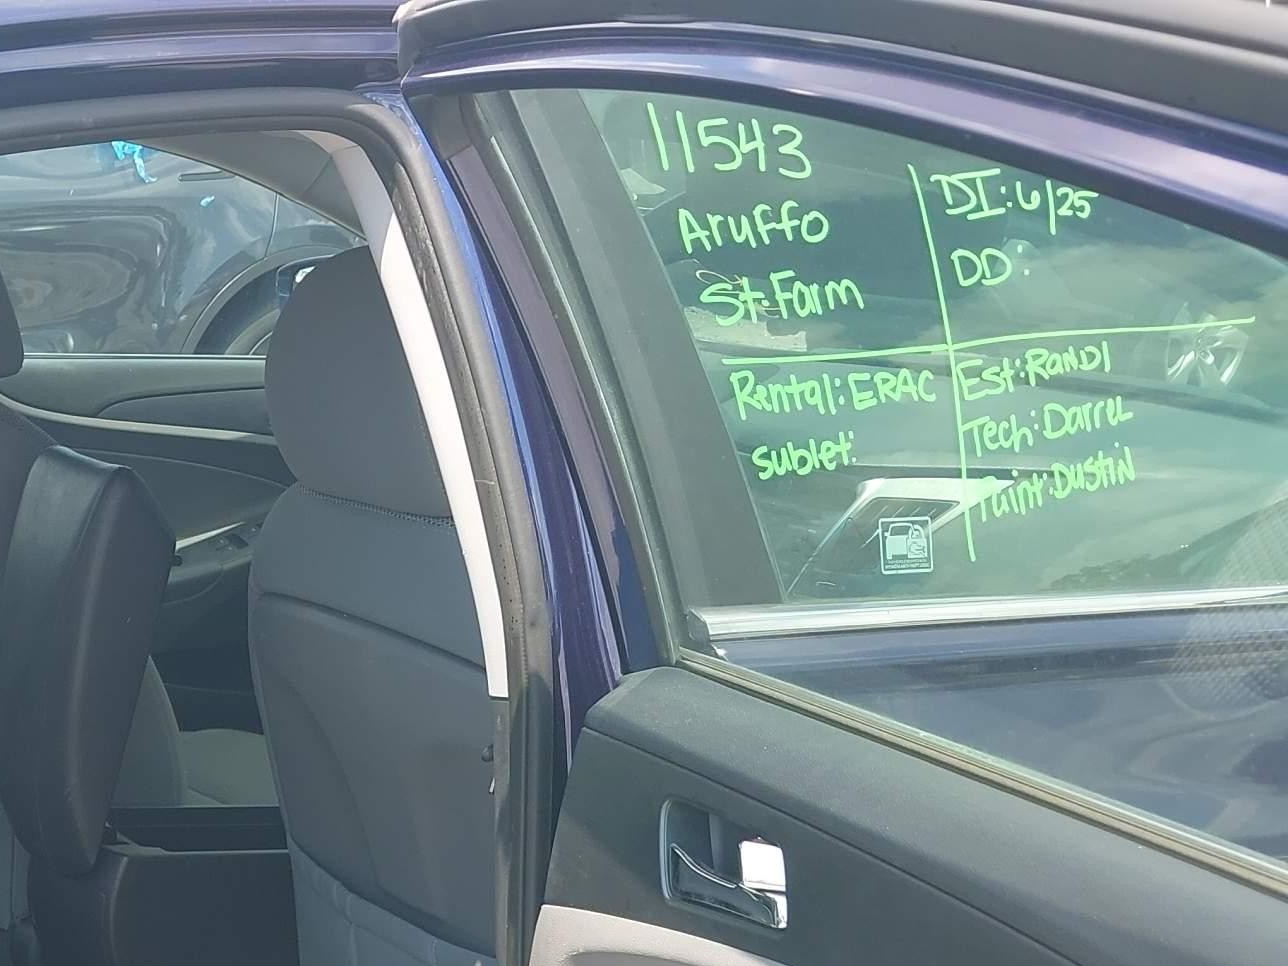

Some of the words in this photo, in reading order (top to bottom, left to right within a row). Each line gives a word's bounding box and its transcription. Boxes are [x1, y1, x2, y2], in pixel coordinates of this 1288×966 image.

[646, 102, 813, 179] 11543
[678, 200, 830, 254] Aruffo
[950, 244, 1031, 287] DD:
